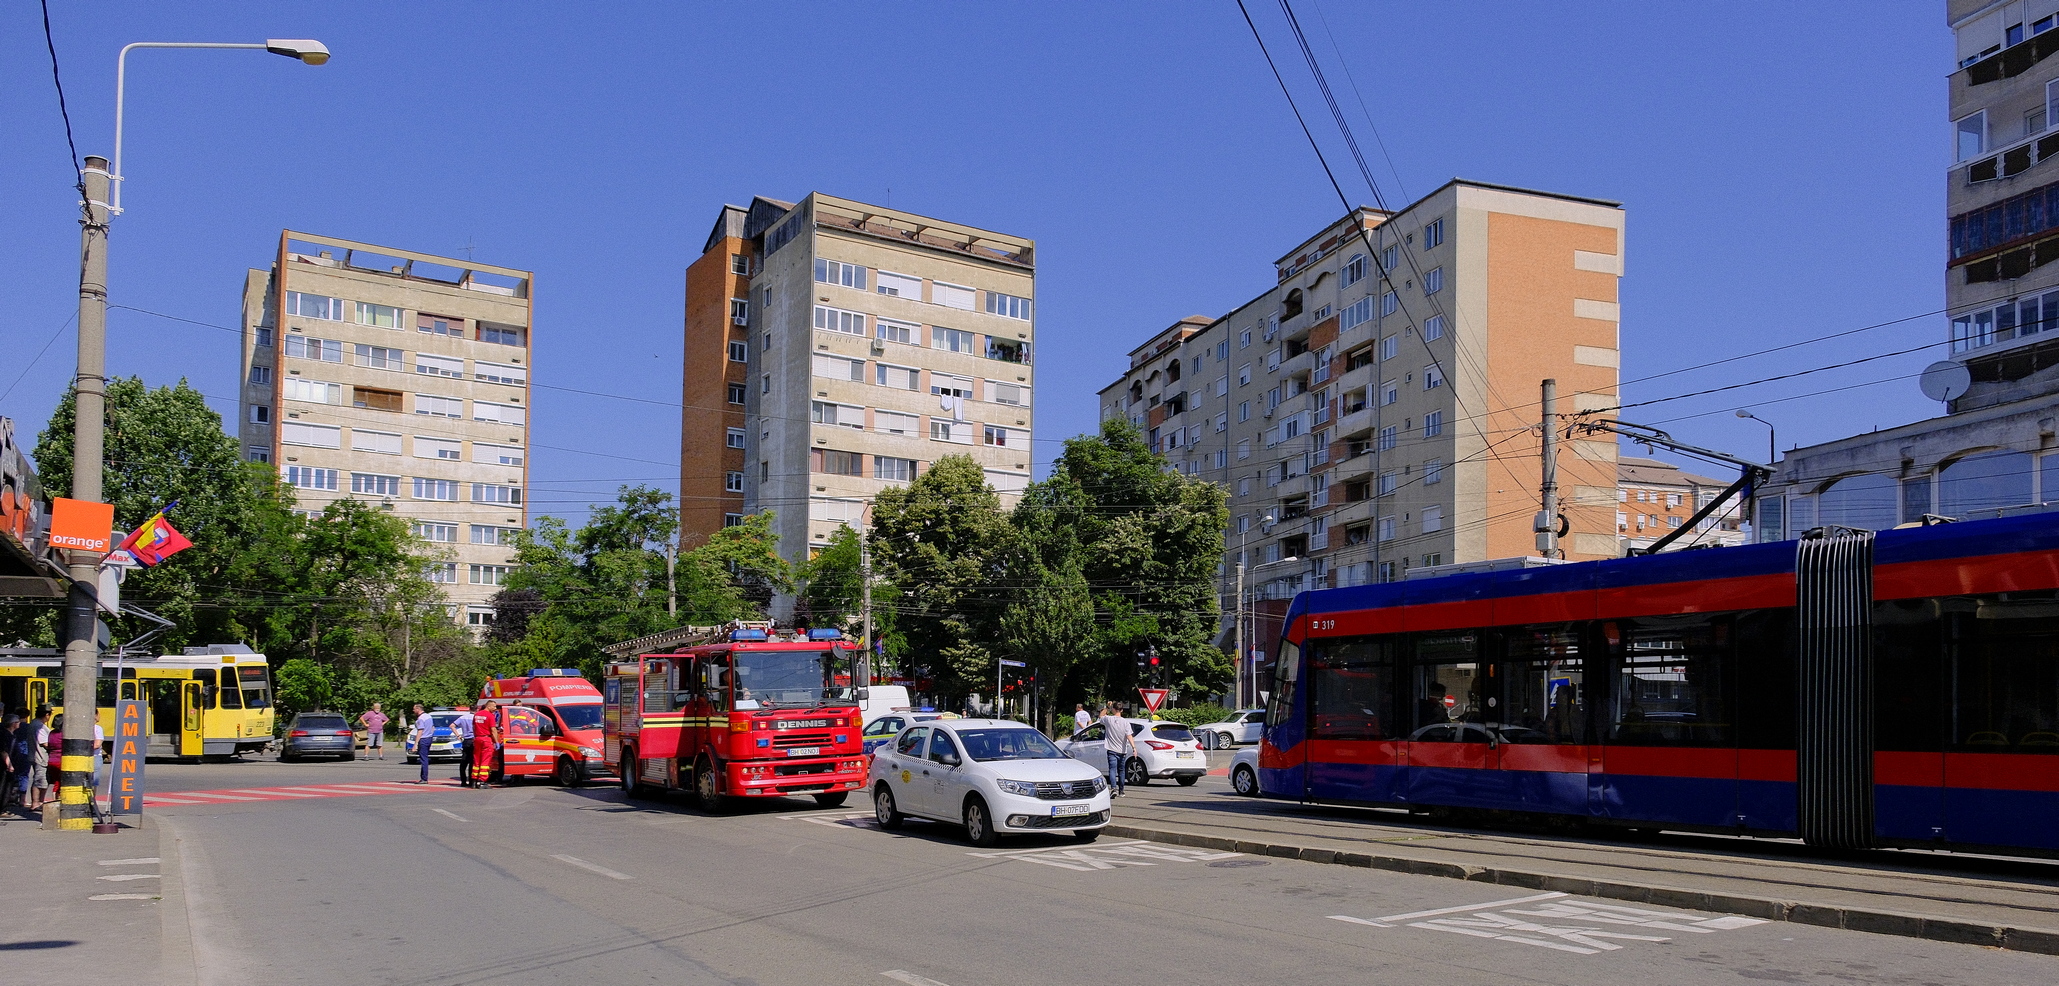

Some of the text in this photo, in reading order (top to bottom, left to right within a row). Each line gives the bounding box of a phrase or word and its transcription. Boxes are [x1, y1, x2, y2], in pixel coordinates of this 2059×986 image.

[53, 535, 103, 549] orange
[1322, 620, 1335, 630] 319
[777, 720, 827, 729] DENNIS
[120, 704, 138, 810] AMANET
